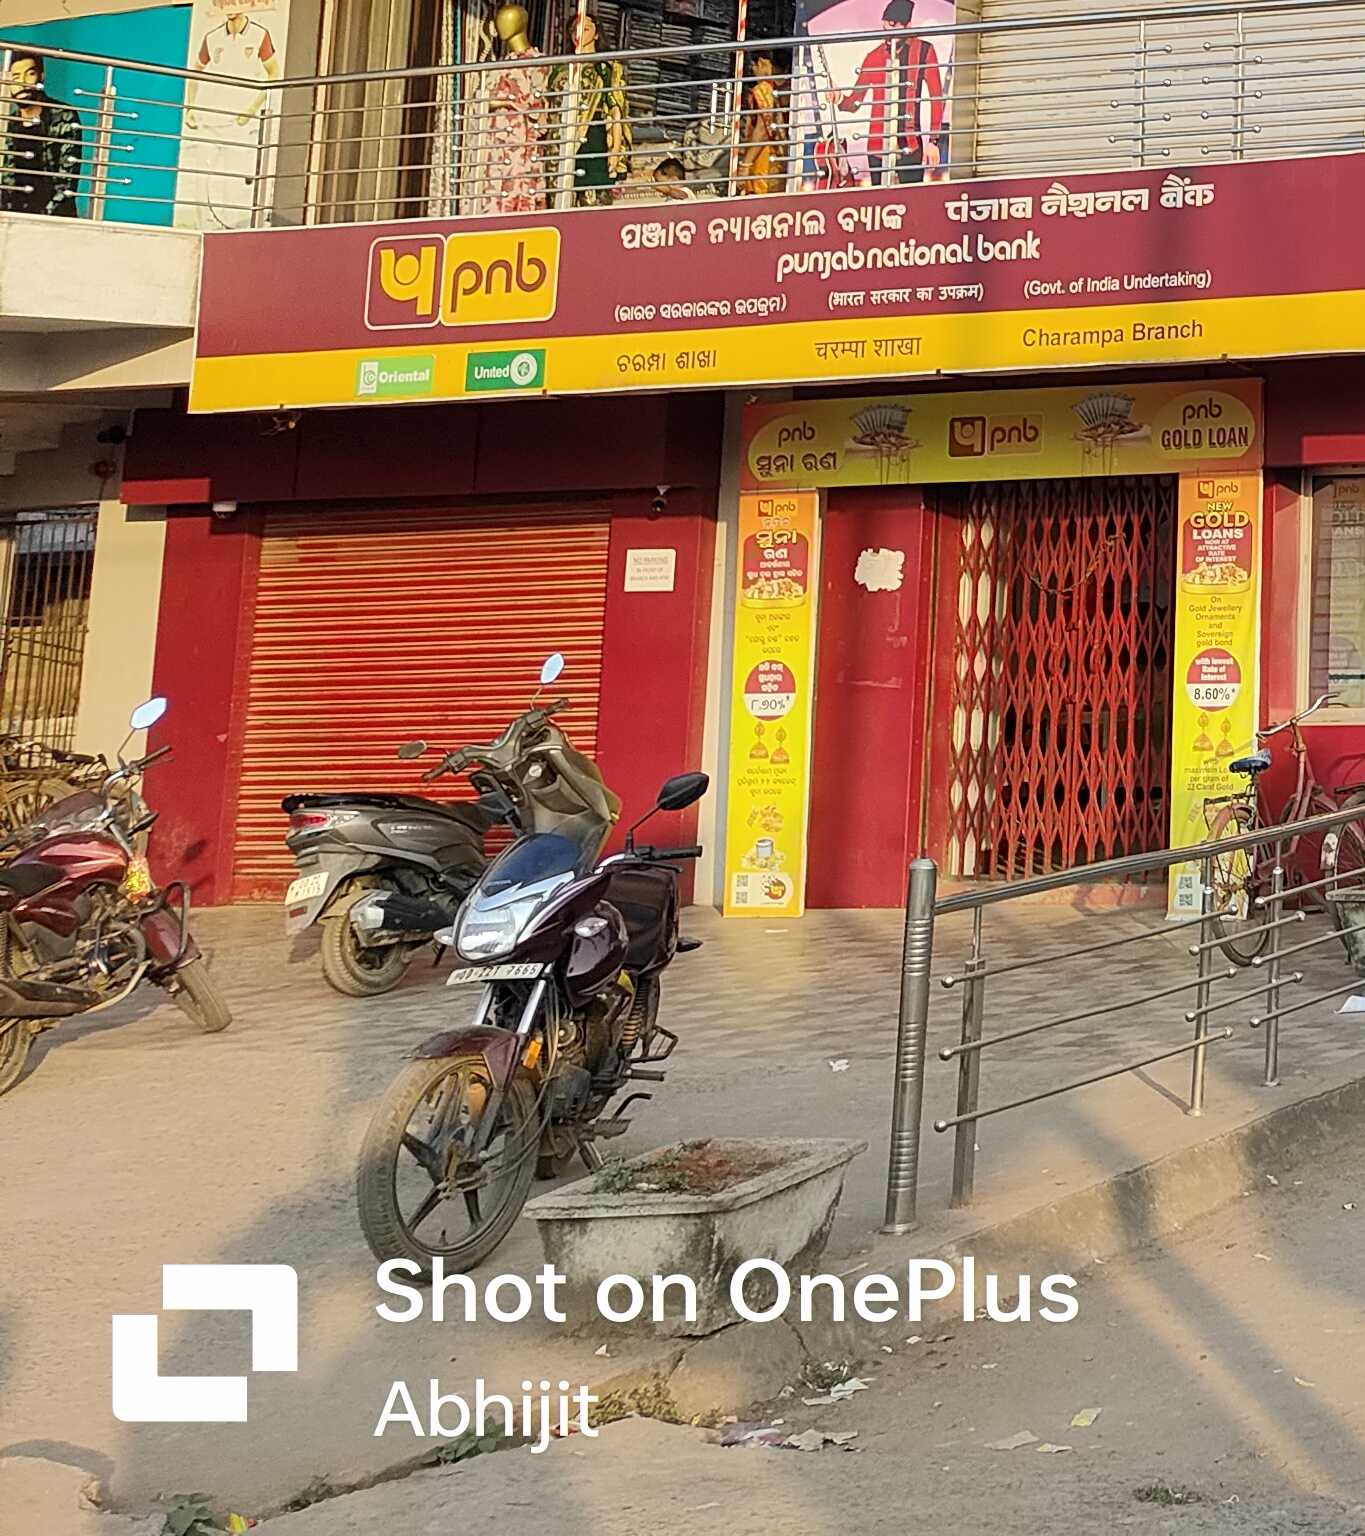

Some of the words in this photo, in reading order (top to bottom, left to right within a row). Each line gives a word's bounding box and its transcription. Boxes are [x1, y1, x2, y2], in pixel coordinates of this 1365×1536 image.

[976, 230, 1041, 263] bank
[450, 241, 548, 313] pnb
[1023, 277, 1067, 300] (Govt.
[1069, 277, 1084, 294] of
[1086, 274, 1120, 293] India
[1123, 269, 1213, 293] Undertaking)
[870, 286, 911, 306] सरकार
[916, 286, 933, 302] का
[1022, 324, 1126, 351] Charampa
[1132, 319, 1203, 342] Branch
[675, 349, 716, 370] ଶାଖା
[814, 337, 867, 362] चरम्पा
[872, 335, 921, 360] शाखा
[379, 368, 429, 384] Oriental
[474, 365, 510, 380] United
[1182, 397, 1222, 425] pnb
[779, 421, 815, 448] pnb
[989, 417, 1039, 451] pnb
[1161, 427, 1202, 450] GOLD
[1208, 424, 1249, 448] LOAN
[1216, 483, 1239, 496] pnb
[775, 502, 796, 515] pnb
[1207, 502, 1232, 511] NEW
[1190, 512, 1249, 528] GOLD
[1193, 529, 1244, 539] LOANS
